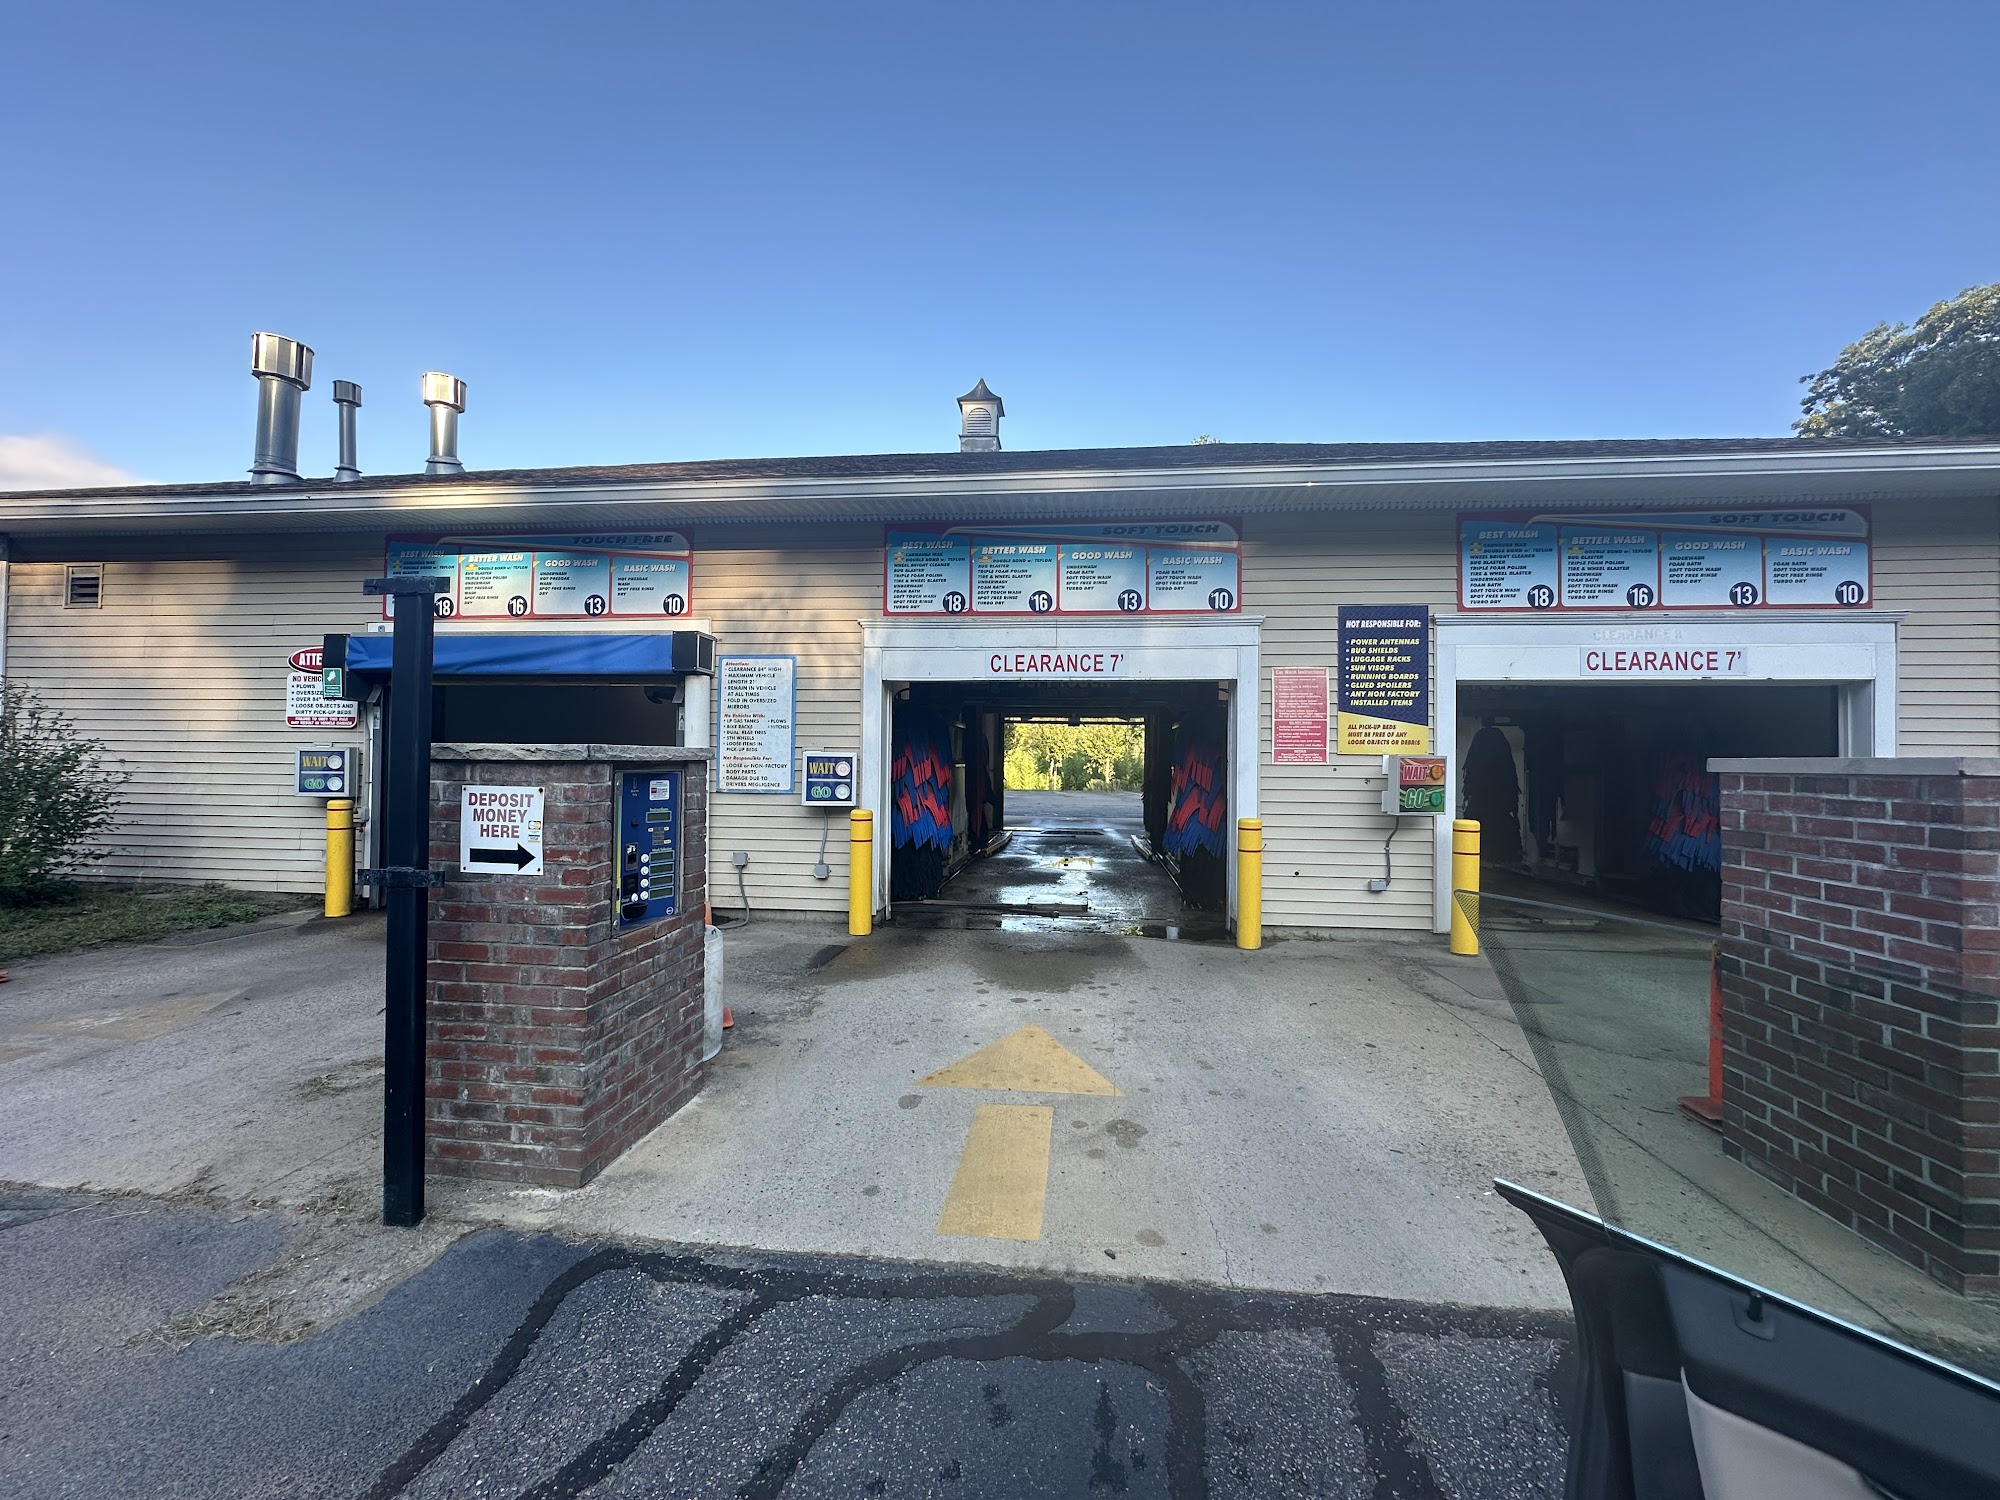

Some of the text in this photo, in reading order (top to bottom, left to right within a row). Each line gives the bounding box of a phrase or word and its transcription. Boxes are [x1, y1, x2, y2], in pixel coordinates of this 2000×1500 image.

[1710, 513, 1846, 524] SOFT TOUCH
[1102, 525, 1219, 535] SOFT TOUCH
[574, 536, 628, 544] TOUCH
[1614, 536, 1645, 544] WASH
[1781, 547, 1850, 556] BASIC WASH
[298, 653, 322, 665] ATTE
[990, 654, 1123, 672] CLEARANCE 7'
[1586, 651, 1741, 670] CLEARANCE 7'
[303, 756, 327, 767] WAIT
[809, 762, 834, 774] WAIT
[1403, 765, 1429, 780] WAIT
[304, 779, 325, 789] GO
[811, 786, 831, 798] GO
[1405, 788, 1426, 808] GO
[469, 793, 534, 807] DEPOSIT
[473, 809, 527, 822] MONEY
[480, 824, 519, 838] HERE
